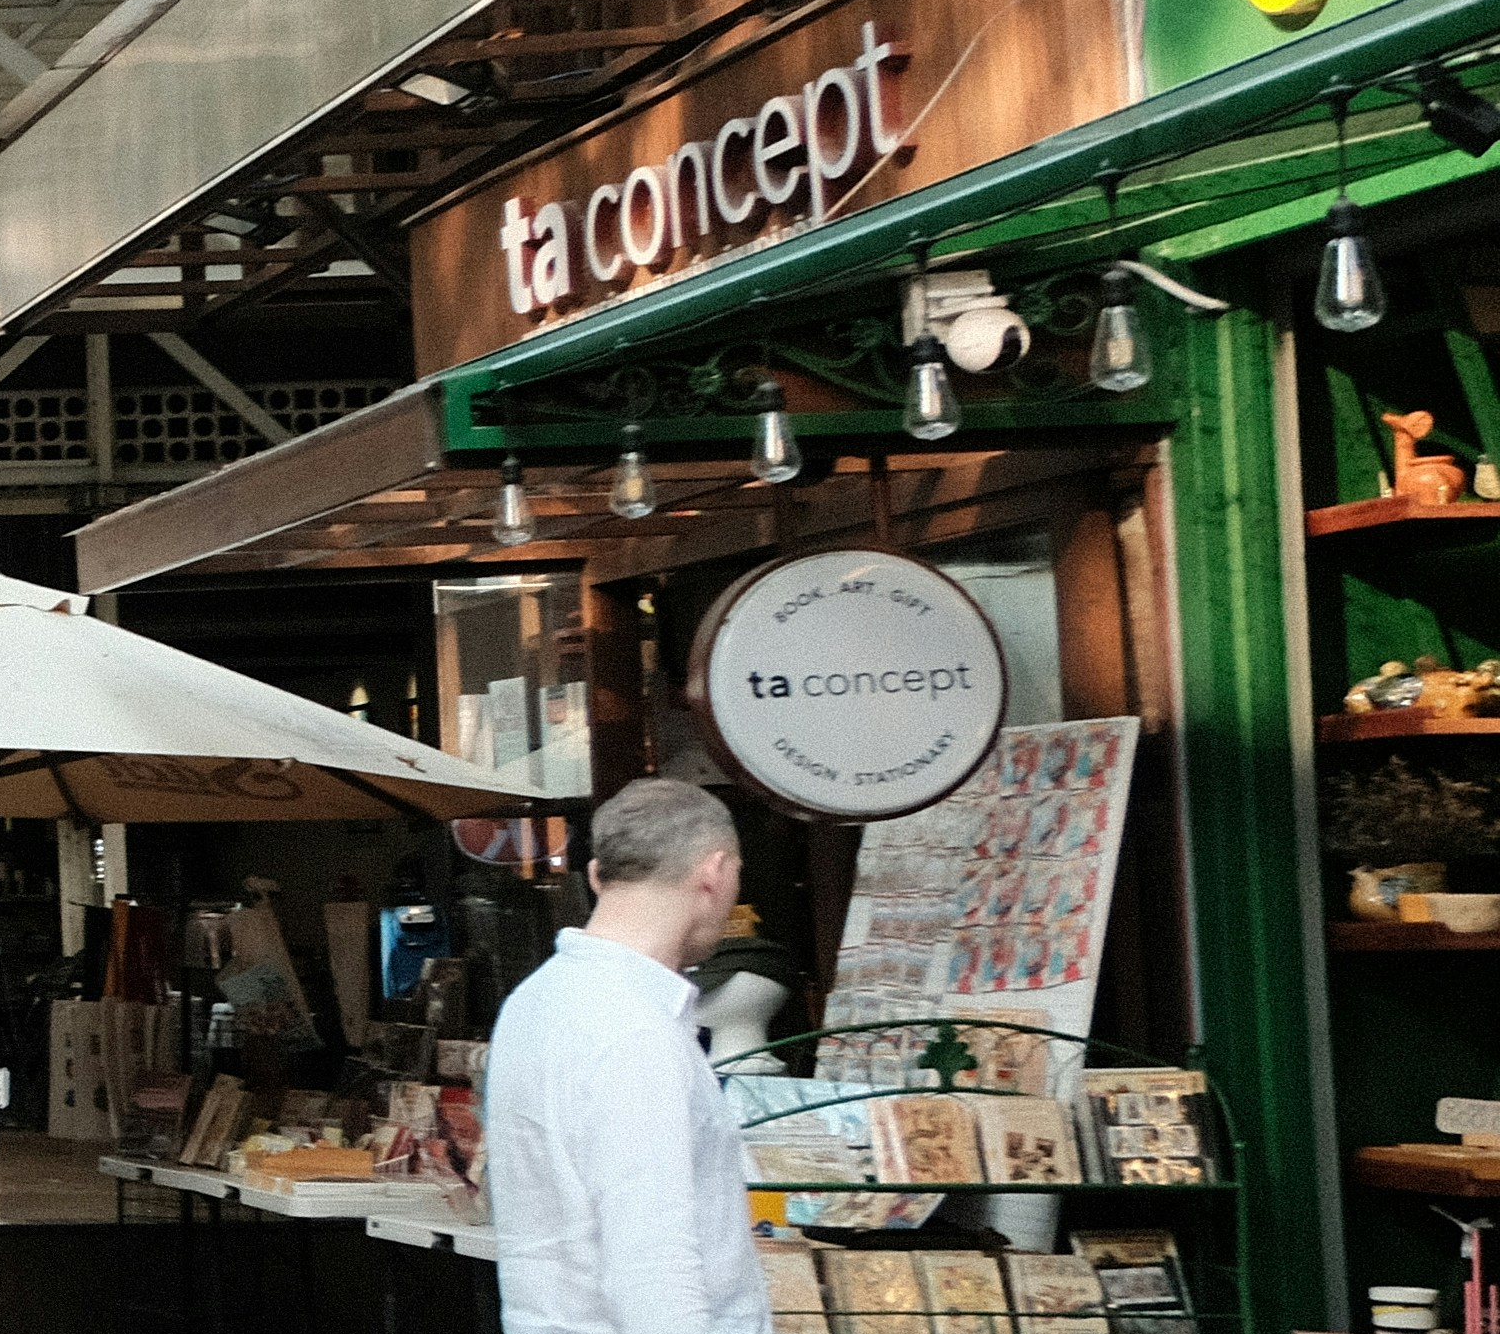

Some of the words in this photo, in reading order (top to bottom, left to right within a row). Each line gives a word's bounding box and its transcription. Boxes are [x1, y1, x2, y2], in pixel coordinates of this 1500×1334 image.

[501, 196, 571, 315] ta
[585, 20, 900, 283] concept
[773, 585, 825, 624] BOOK
[839, 579, 875, 597] ART
[889, 587, 935, 620] GIFT
[748, 670, 792, 699] ta
[802, 661, 973, 702] concept
[773, 736, 840, 780] DESIGN
[855, 730, 956, 787] STATIONARY
